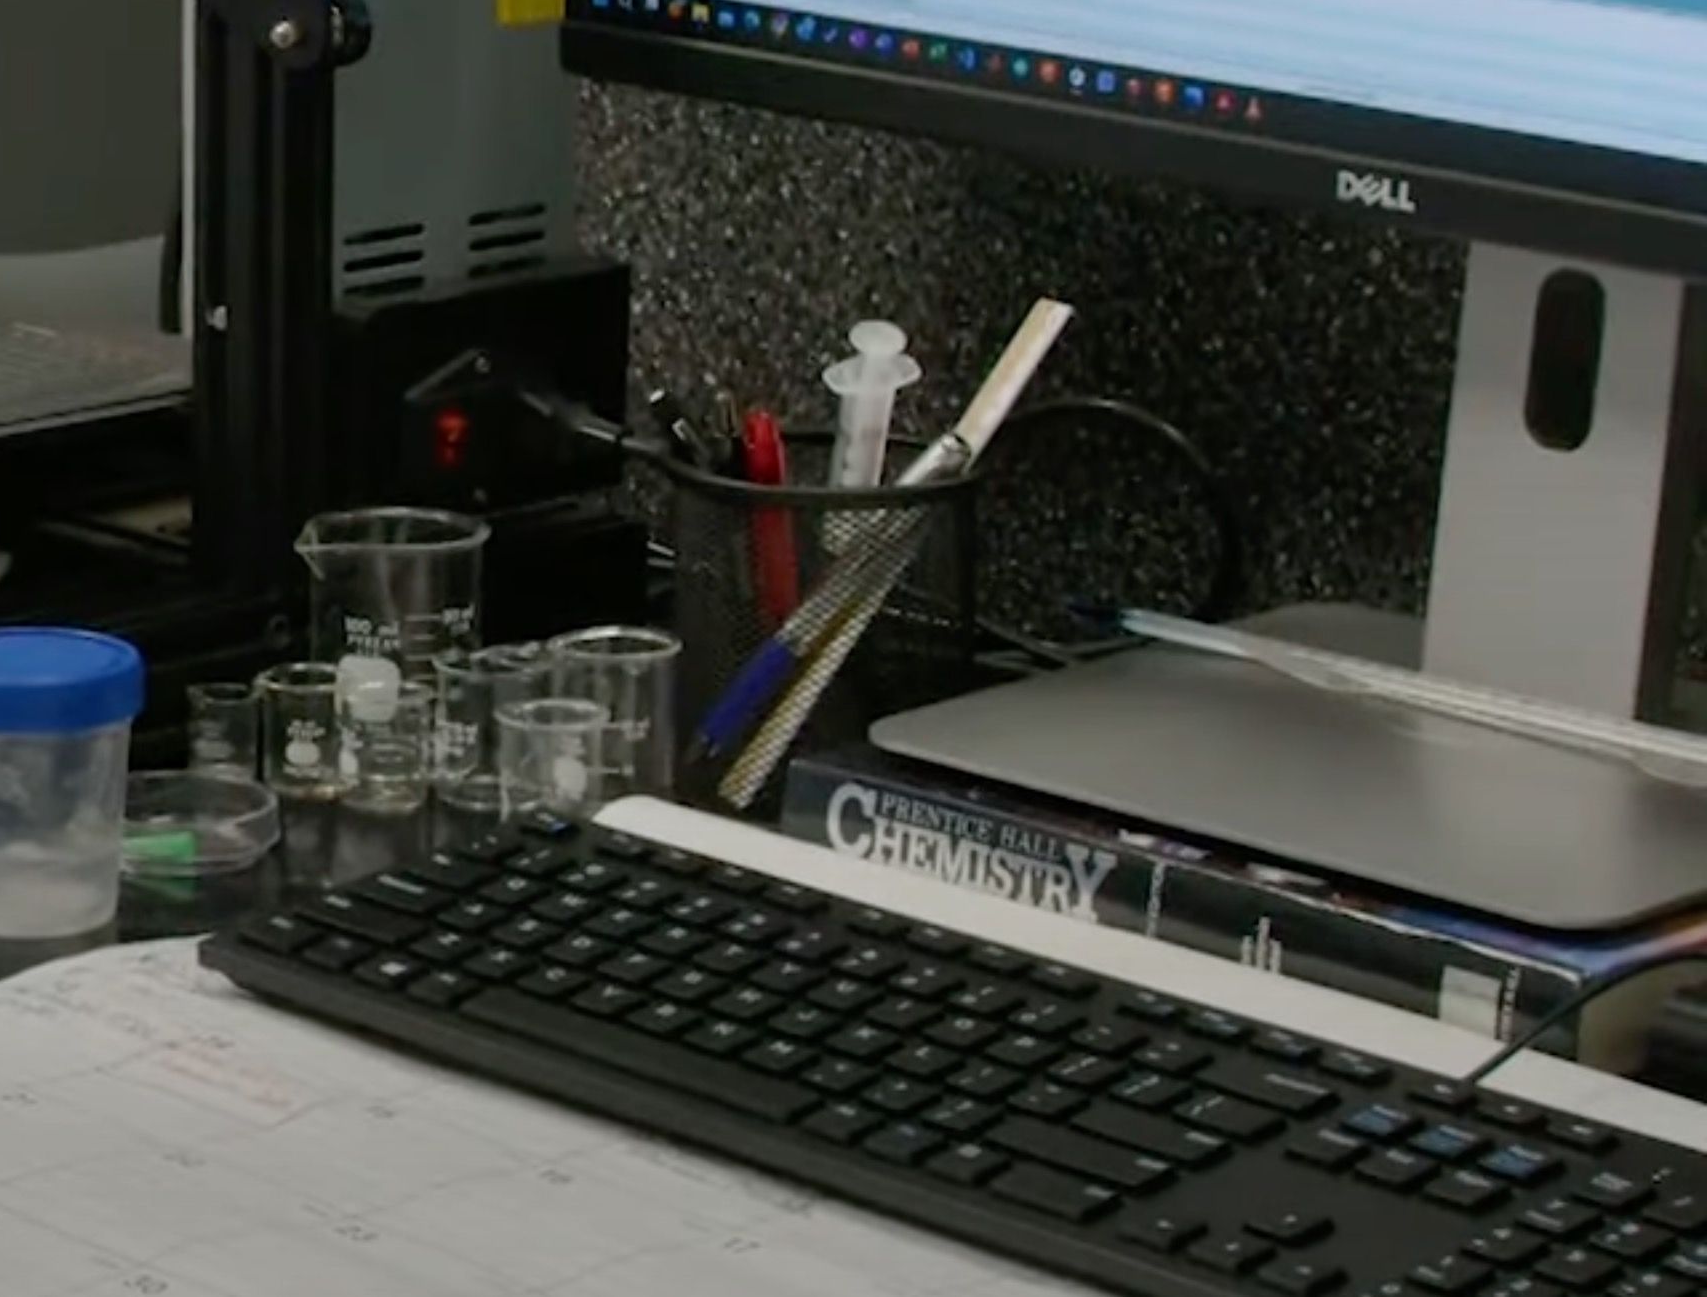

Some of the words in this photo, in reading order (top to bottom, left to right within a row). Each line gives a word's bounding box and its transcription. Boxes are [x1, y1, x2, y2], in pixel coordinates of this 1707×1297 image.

[1336, 169, 1417, 214] DELL
[826, 781, 1117, 925] CHEMISTRY
[882, 793, 994, 844] PRENTICE
[999, 824, 1061, 861] HALL
